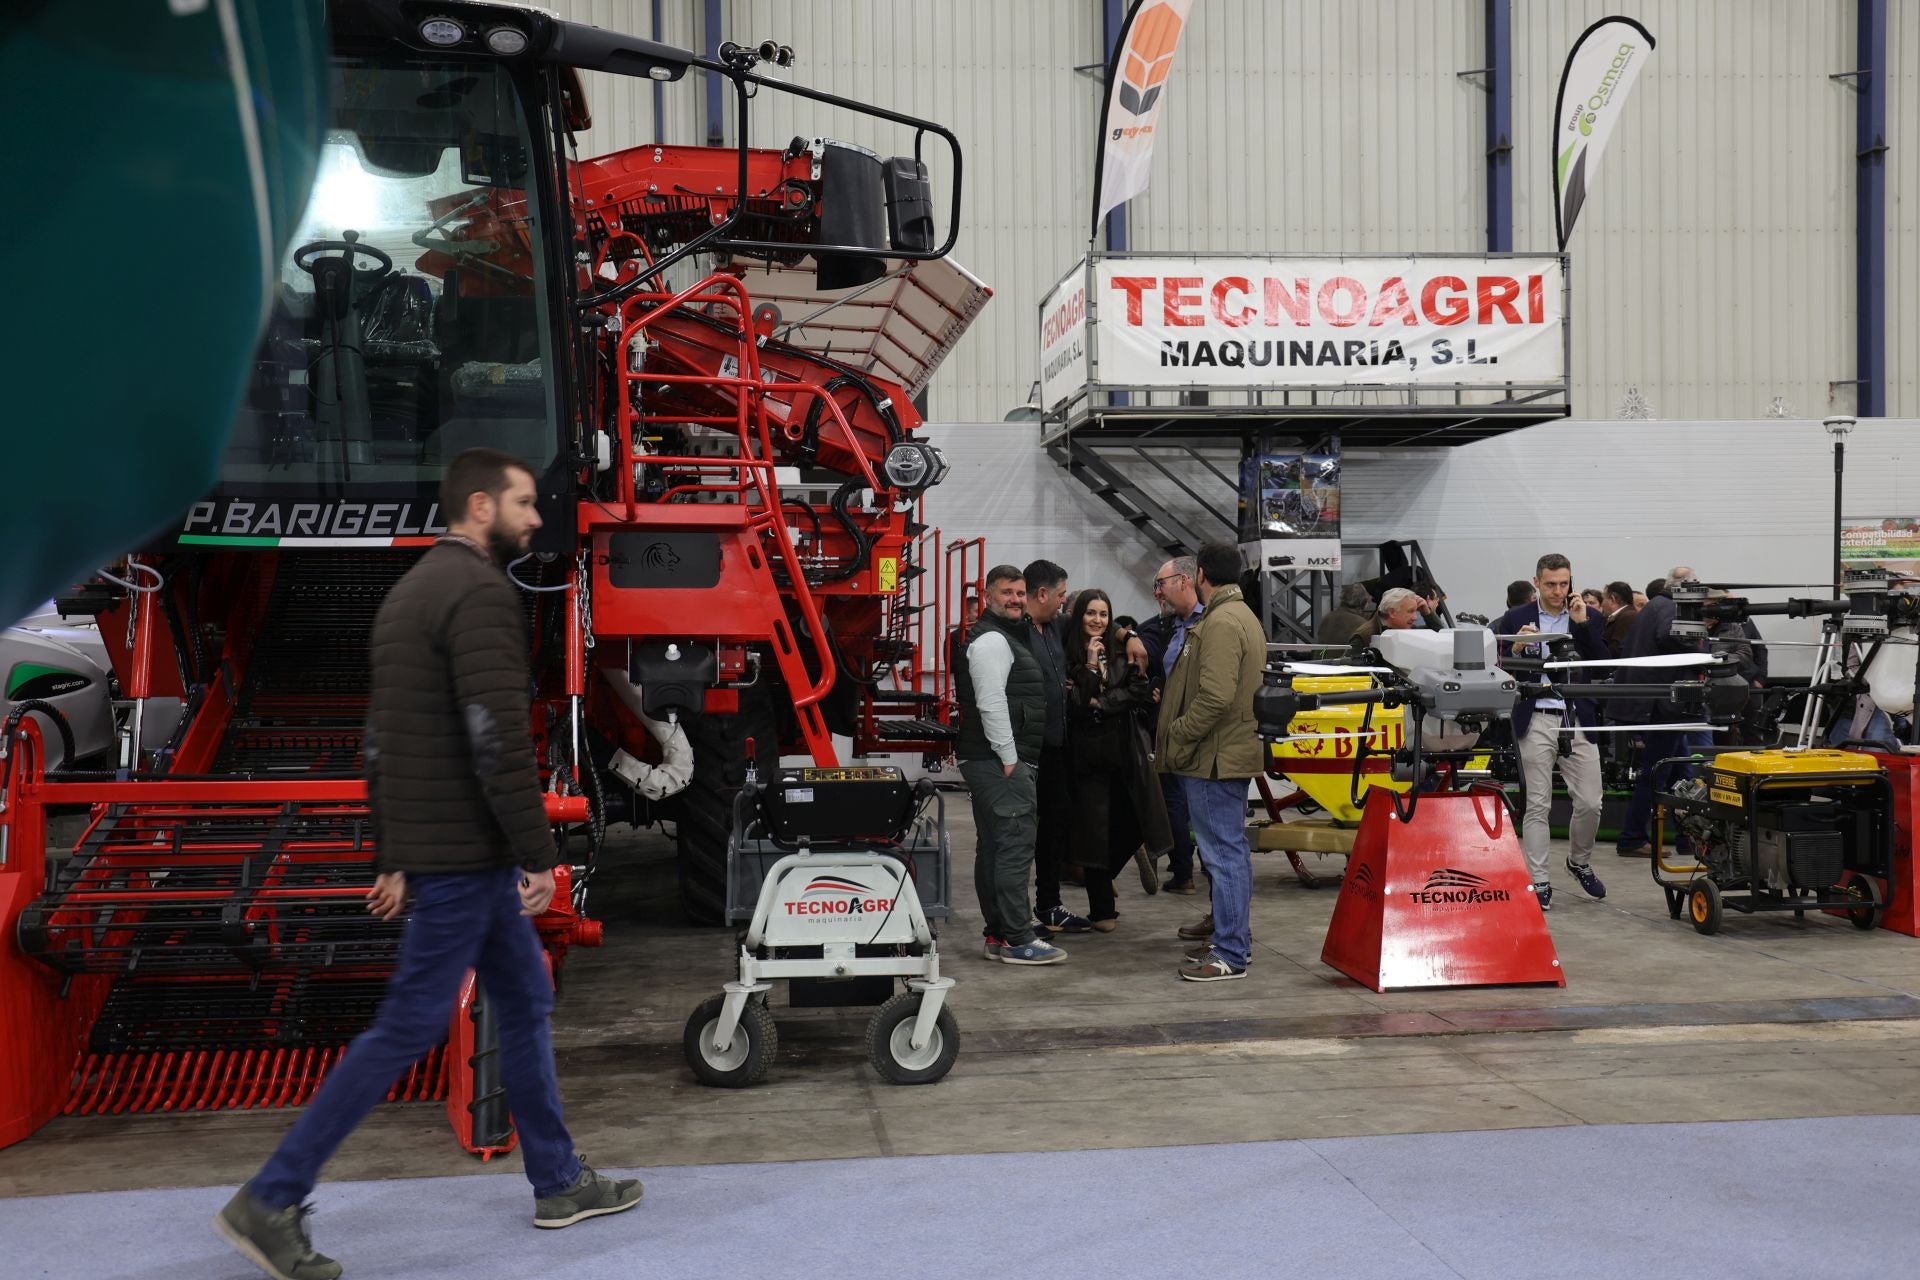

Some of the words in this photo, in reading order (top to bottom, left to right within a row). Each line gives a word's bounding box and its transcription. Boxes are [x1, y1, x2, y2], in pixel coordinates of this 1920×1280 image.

[1588, 42, 1636, 110] Osmaq
[1568, 104, 1584, 132] group
[1111, 274, 1544, 328] TECNOAGRI
[1161, 339, 1418, 371] MAQUINARIA,
[1431, 338, 1498, 364] S.L.
[1840, 529, 1913, 539] Compatibilidad
[1840, 538, 1887, 546] extendida
[784, 896, 895, 915] TECNOAGRI
[1410, 888, 1510, 904] TECNOAGRI
[808, 916, 863, 925] maquinaria
